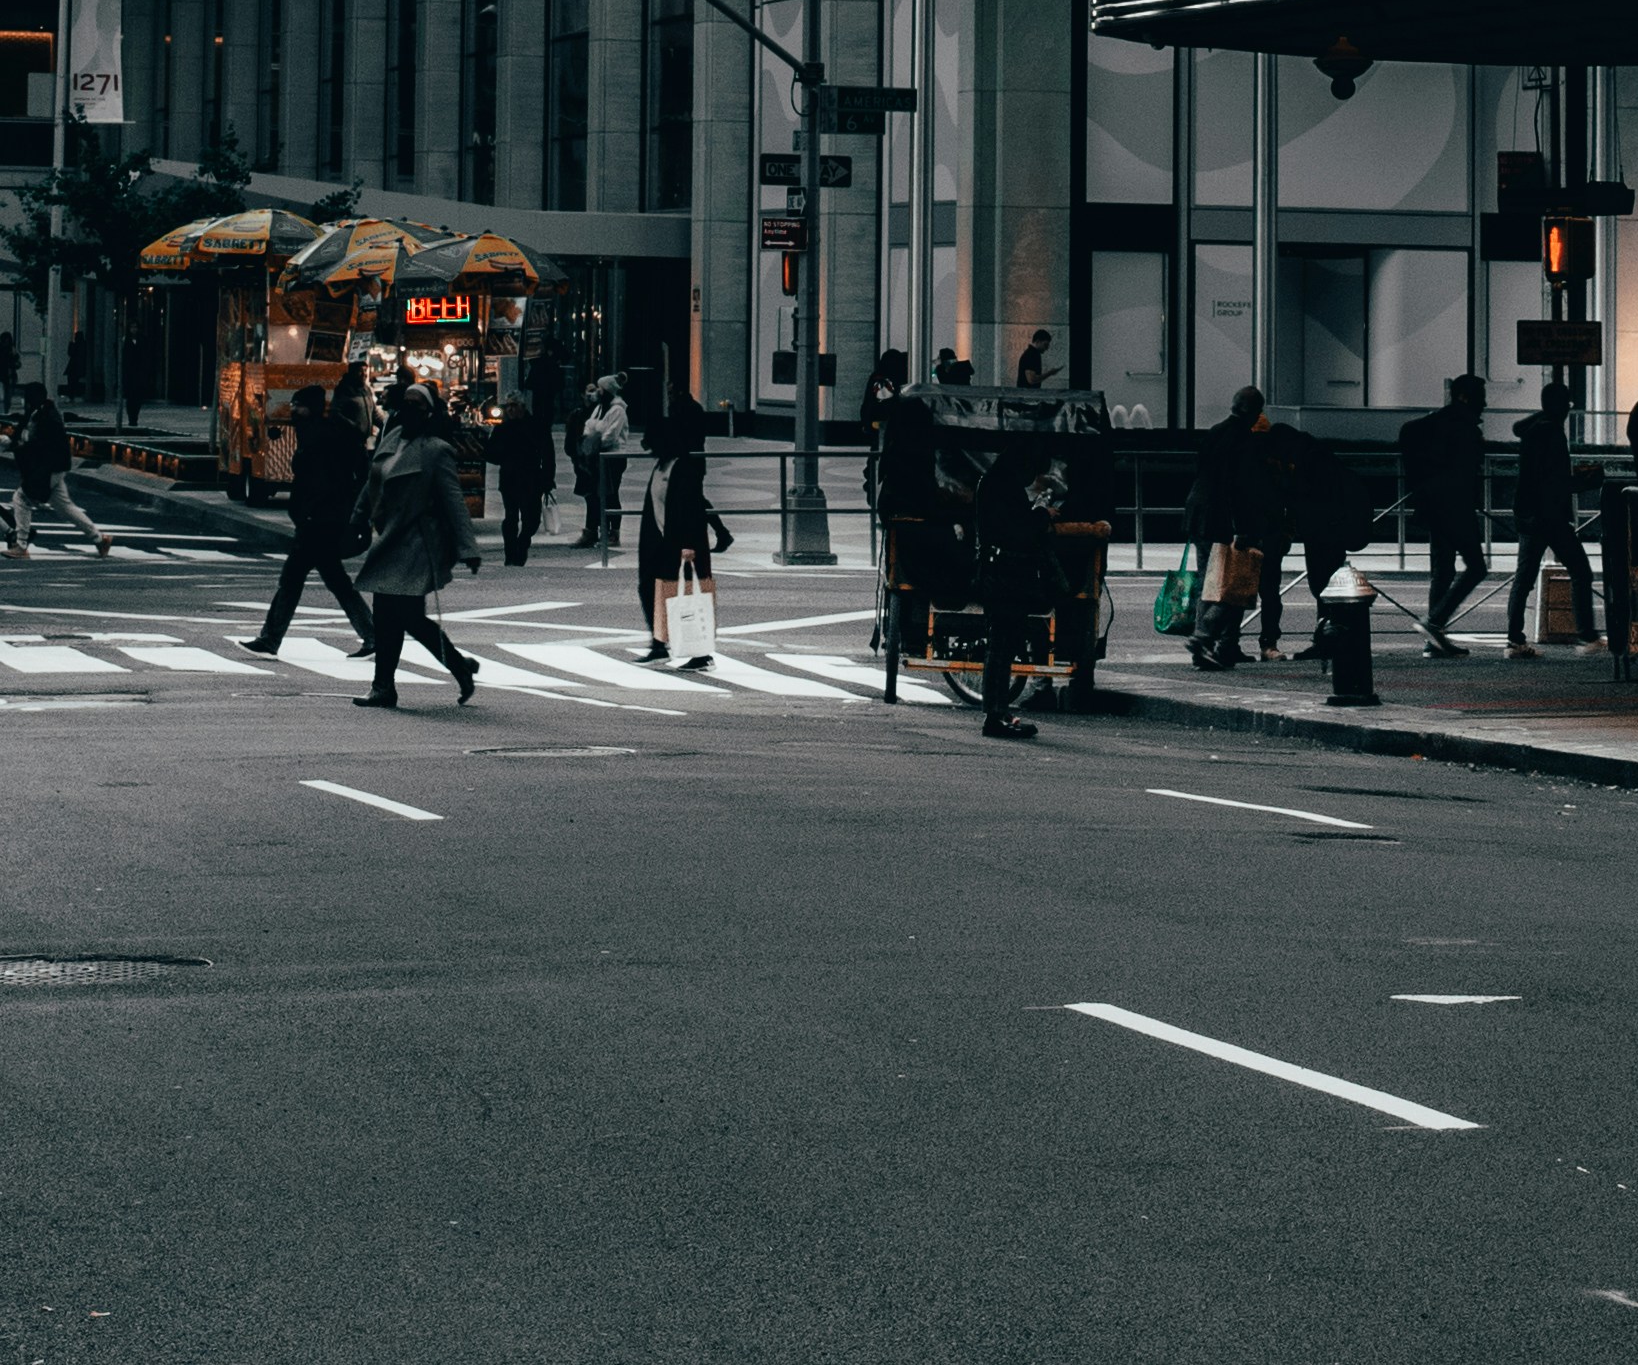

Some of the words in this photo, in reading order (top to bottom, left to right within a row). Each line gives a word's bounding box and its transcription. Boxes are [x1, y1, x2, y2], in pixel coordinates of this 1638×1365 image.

[73, 73, 119, 95] 1271
[843, 95, 913, 109] AMERICAS
[845, 114, 858, 131] 6
[768, 163, 796, 176] ONE
